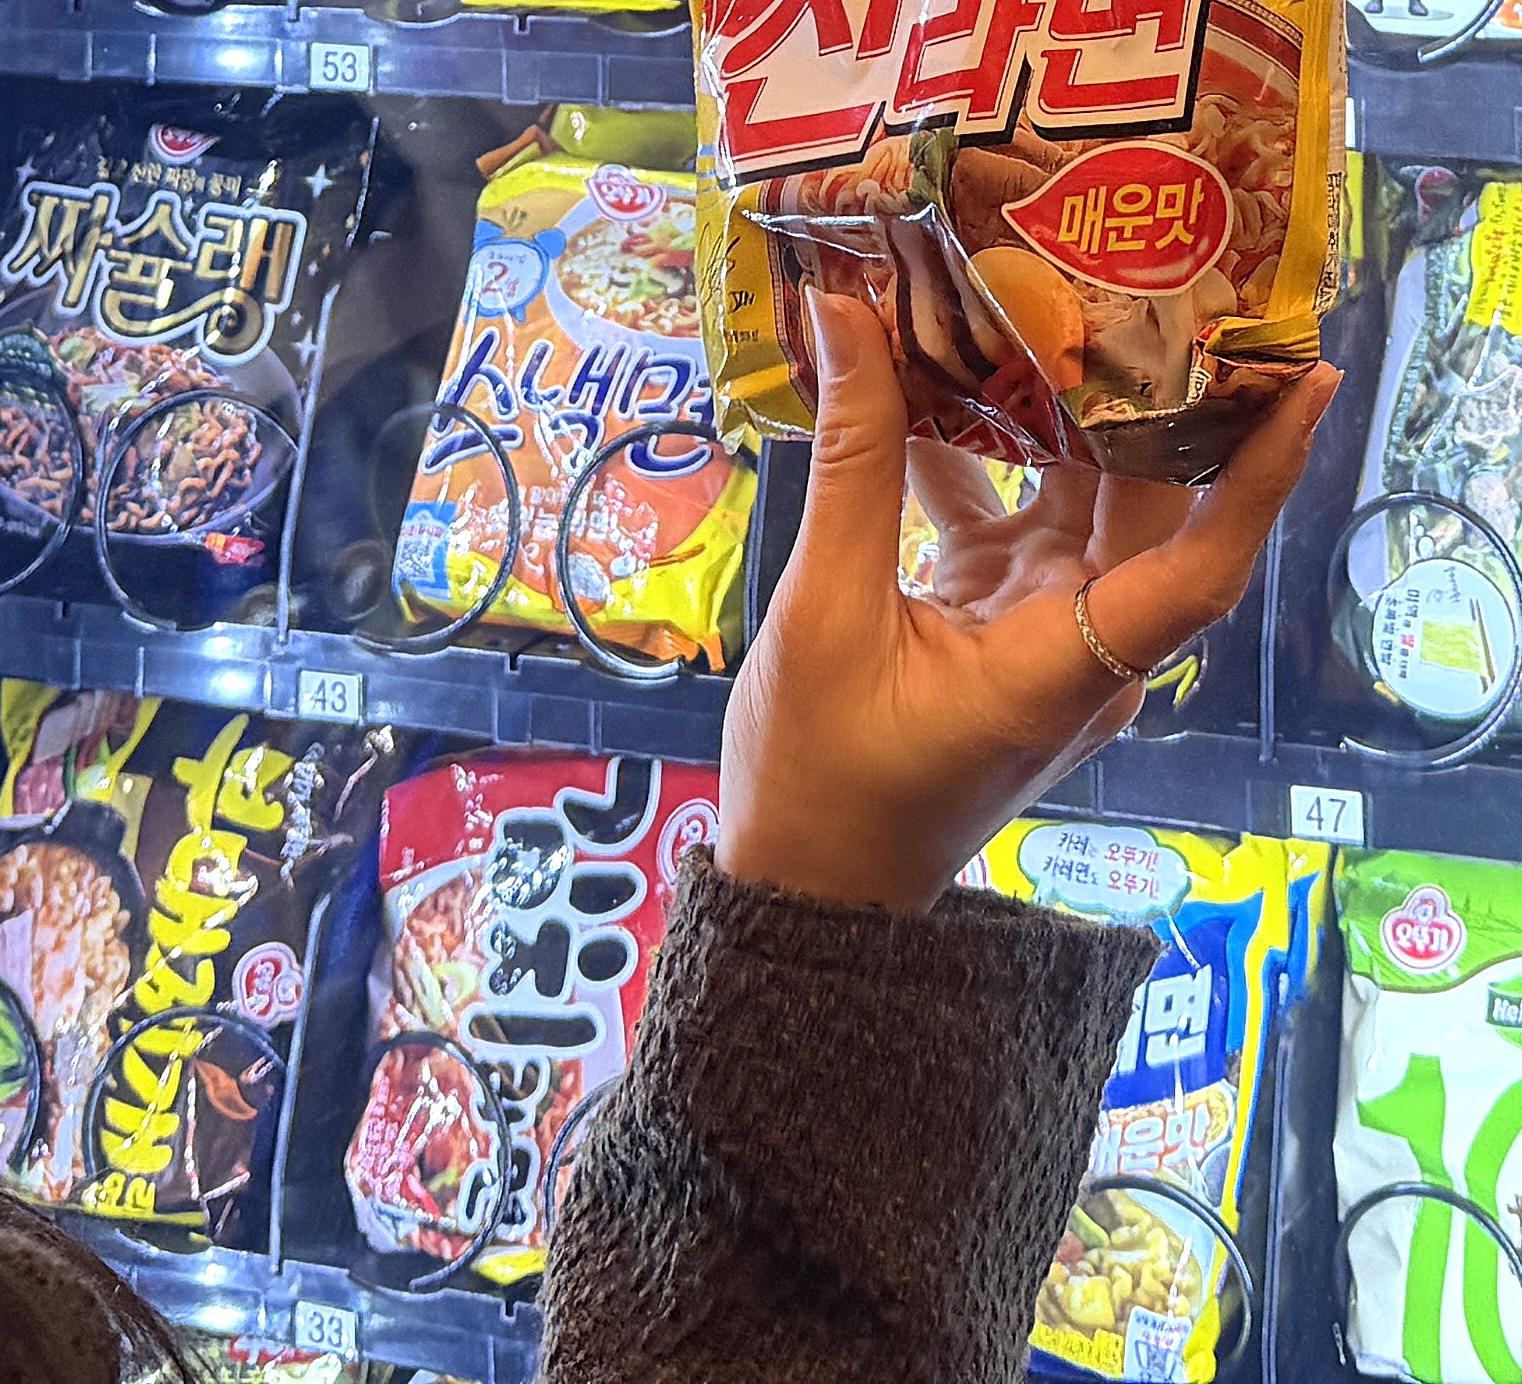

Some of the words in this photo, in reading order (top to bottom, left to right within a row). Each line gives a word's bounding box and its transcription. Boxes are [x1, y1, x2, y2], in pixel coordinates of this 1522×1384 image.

[323, 53, 359, 83] 53
[1056, 180, 1205, 255] 매운맛
[6, 186, 299, 360] 짜슐랭
[422, 326, 715, 478] 스낵면
[311, 677, 348, 710] 43
[1306, 797, 1348, 832] 47
[1394, 918, 1449, 954] 오뚜기
[307, 1315, 344, 1348] 33
